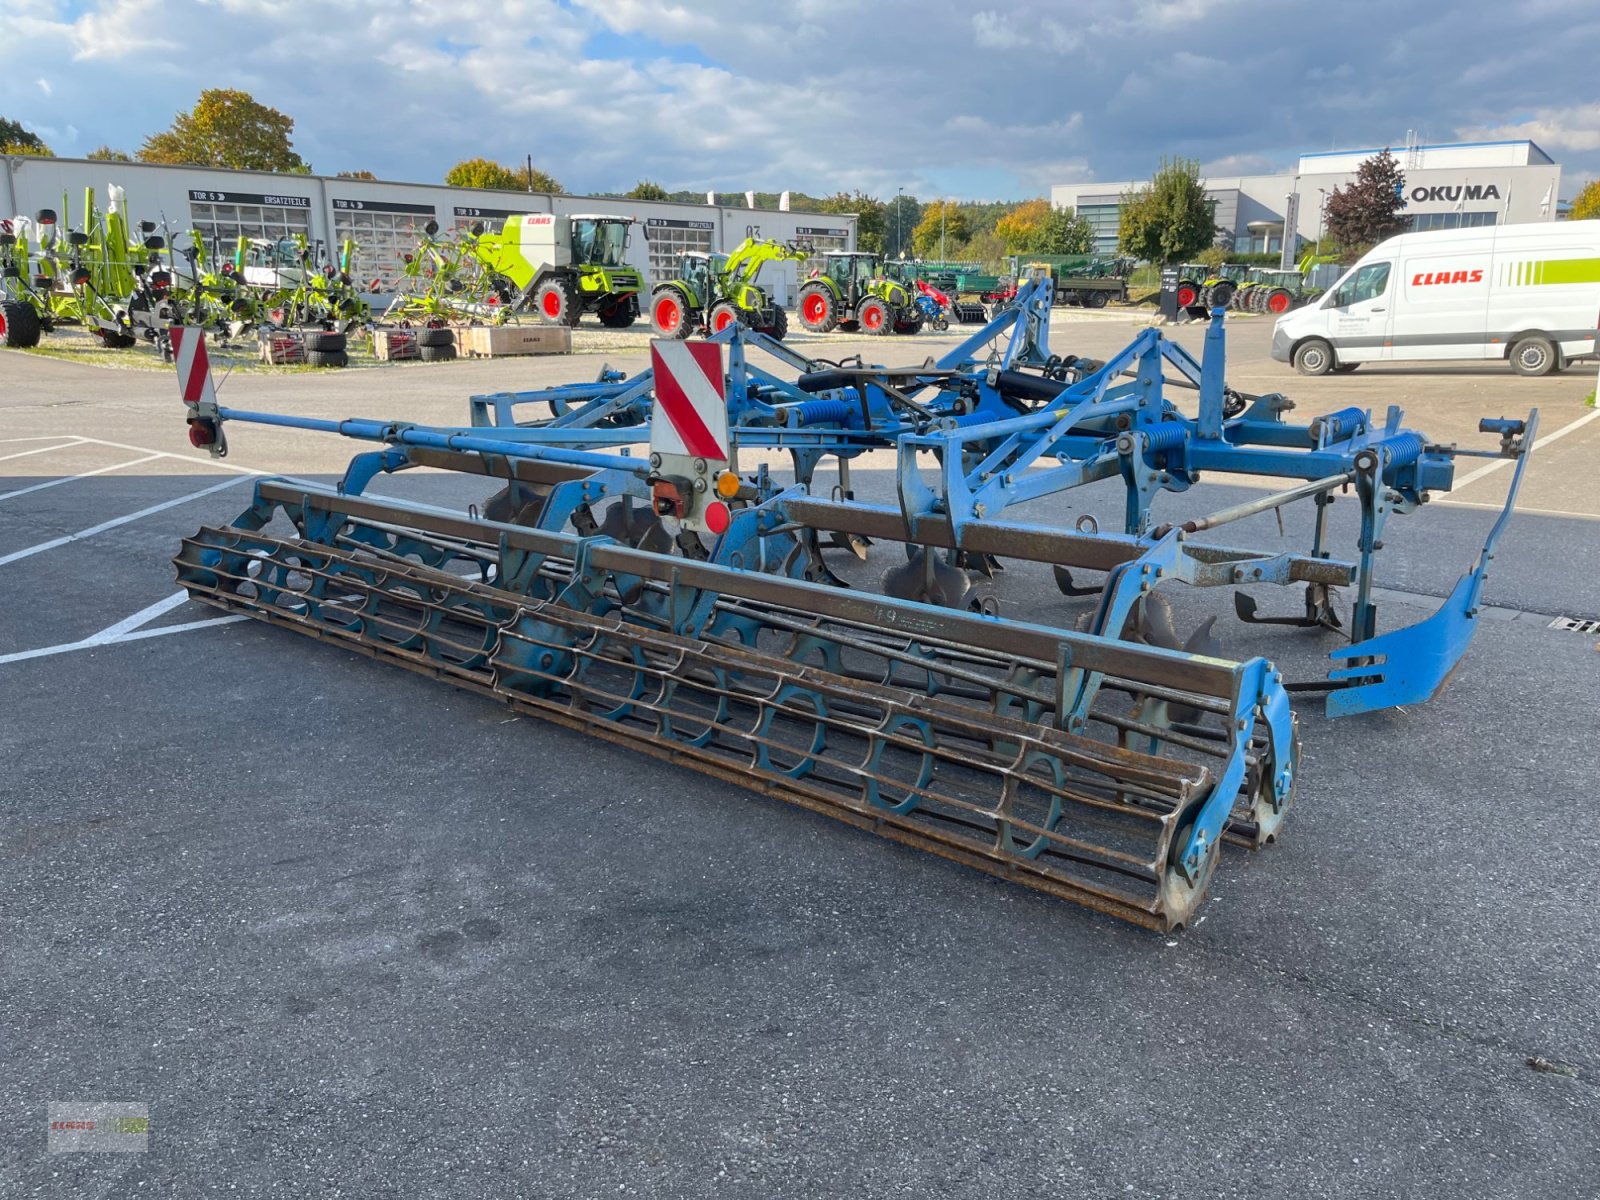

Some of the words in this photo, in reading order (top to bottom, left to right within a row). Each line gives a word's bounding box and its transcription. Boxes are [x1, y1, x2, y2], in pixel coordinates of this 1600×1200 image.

[193, 191, 207, 200] TOR
[209, 192, 215, 201] 5
[264, 196, 307, 207] ERSATZTEILE
[1411, 185, 1501, 203] OKUMA
[336, 200, 348, 208] TOR
[527, 217, 552, 225] CLAAS
[1411, 269, 1484, 286] CLAAS
